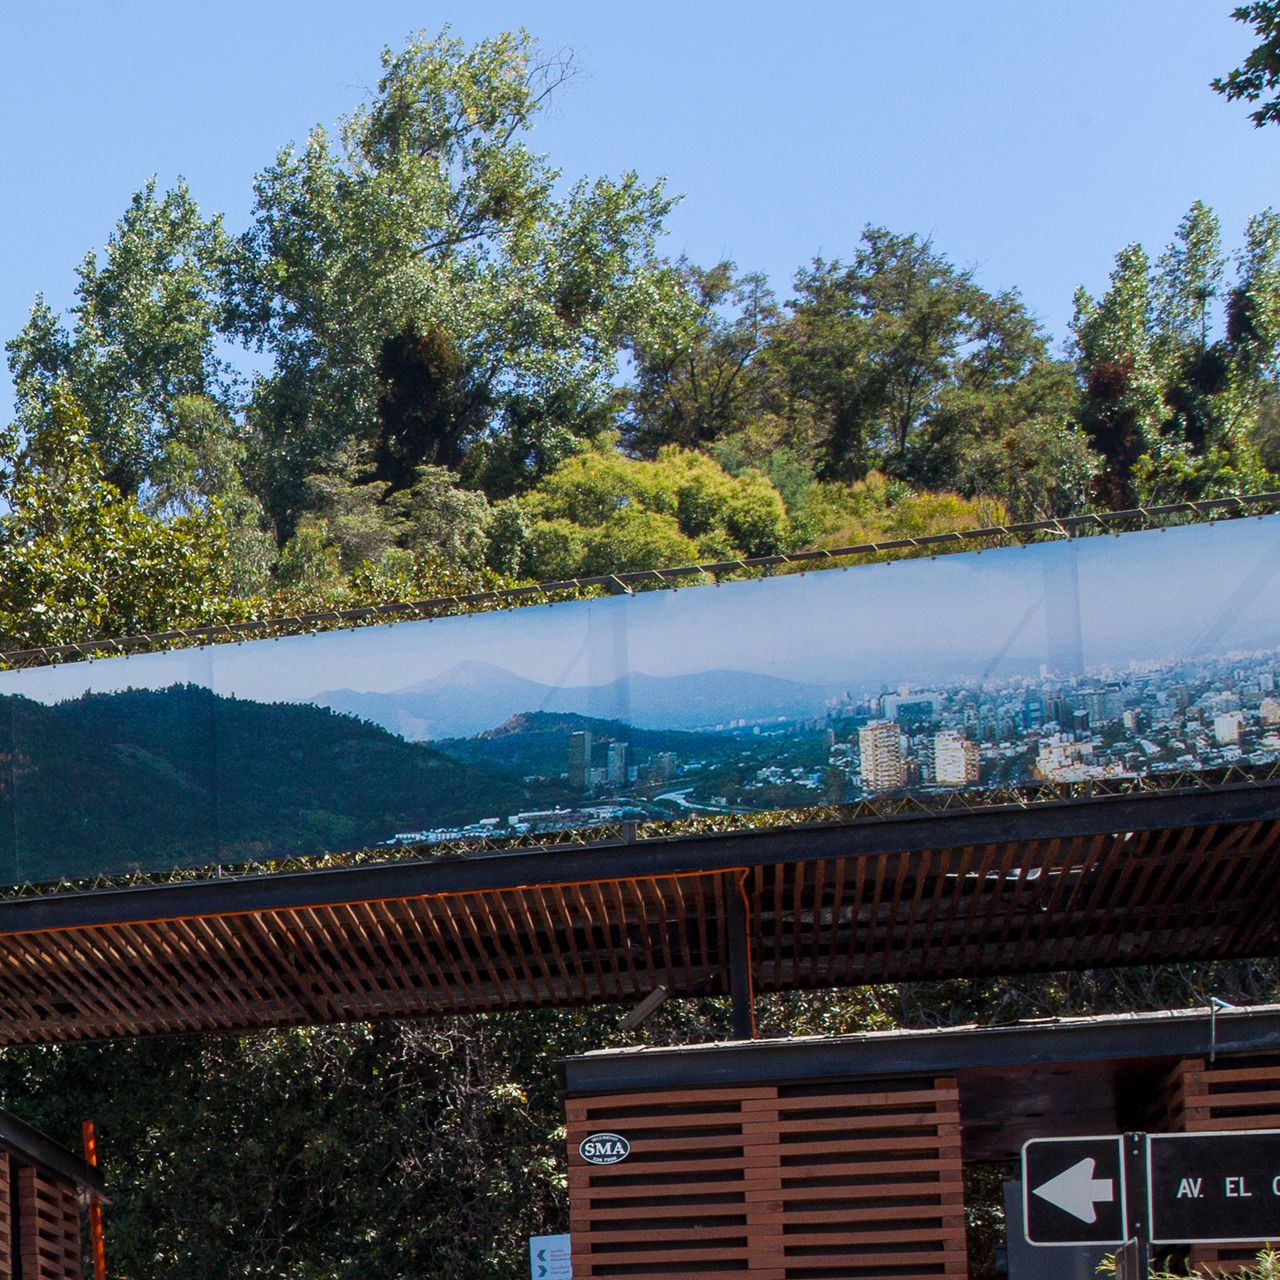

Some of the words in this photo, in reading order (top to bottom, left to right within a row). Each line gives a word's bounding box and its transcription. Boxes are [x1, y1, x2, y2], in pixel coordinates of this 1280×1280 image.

[585, 1142, 625, 1155] SMA
[1177, 1178, 1204, 1198] AV.
[1226, 1177, 1252, 1197] EL
